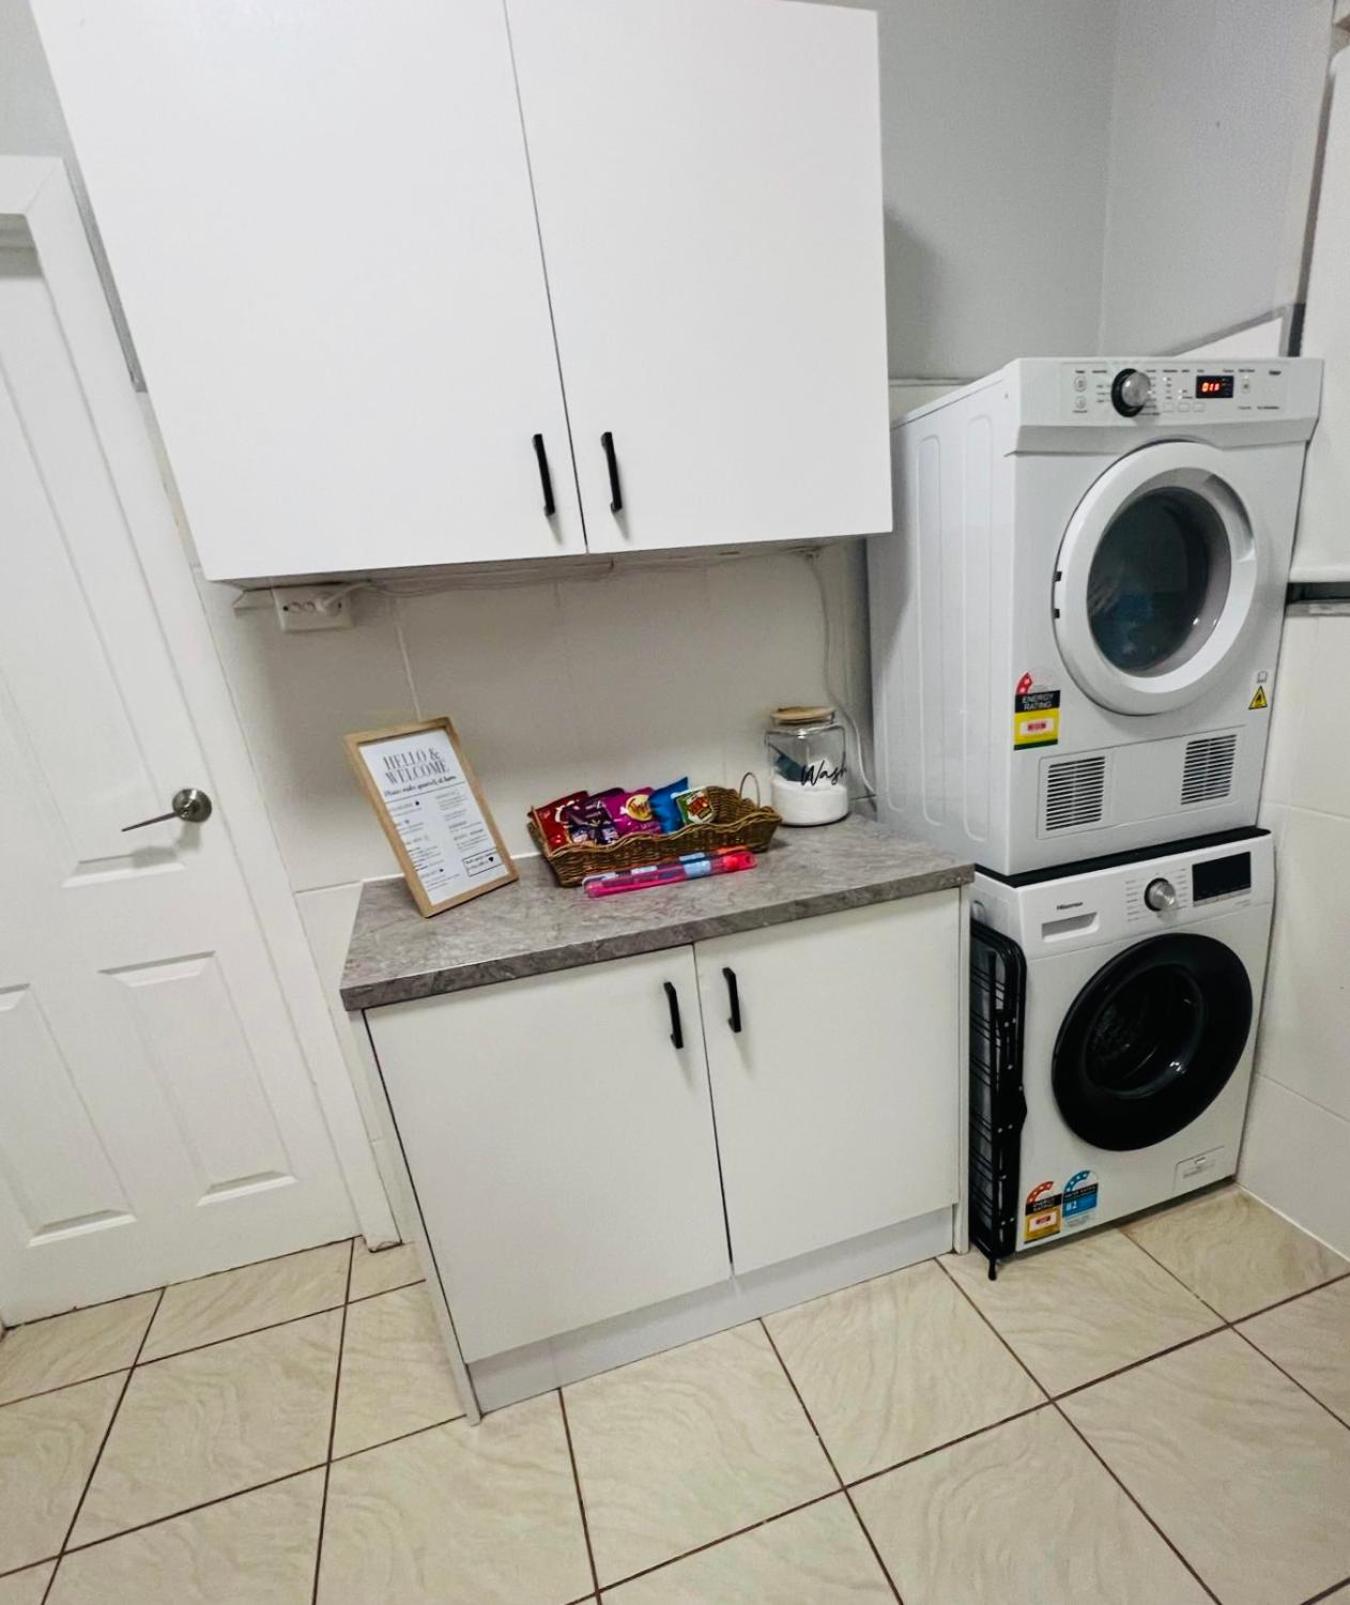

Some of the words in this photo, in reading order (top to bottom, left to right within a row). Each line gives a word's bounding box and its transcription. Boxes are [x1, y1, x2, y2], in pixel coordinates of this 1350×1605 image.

[383, 749, 427, 770] HELLO
[428, 747, 441, 761] &
[385, 760, 449, 785] WELCOME
